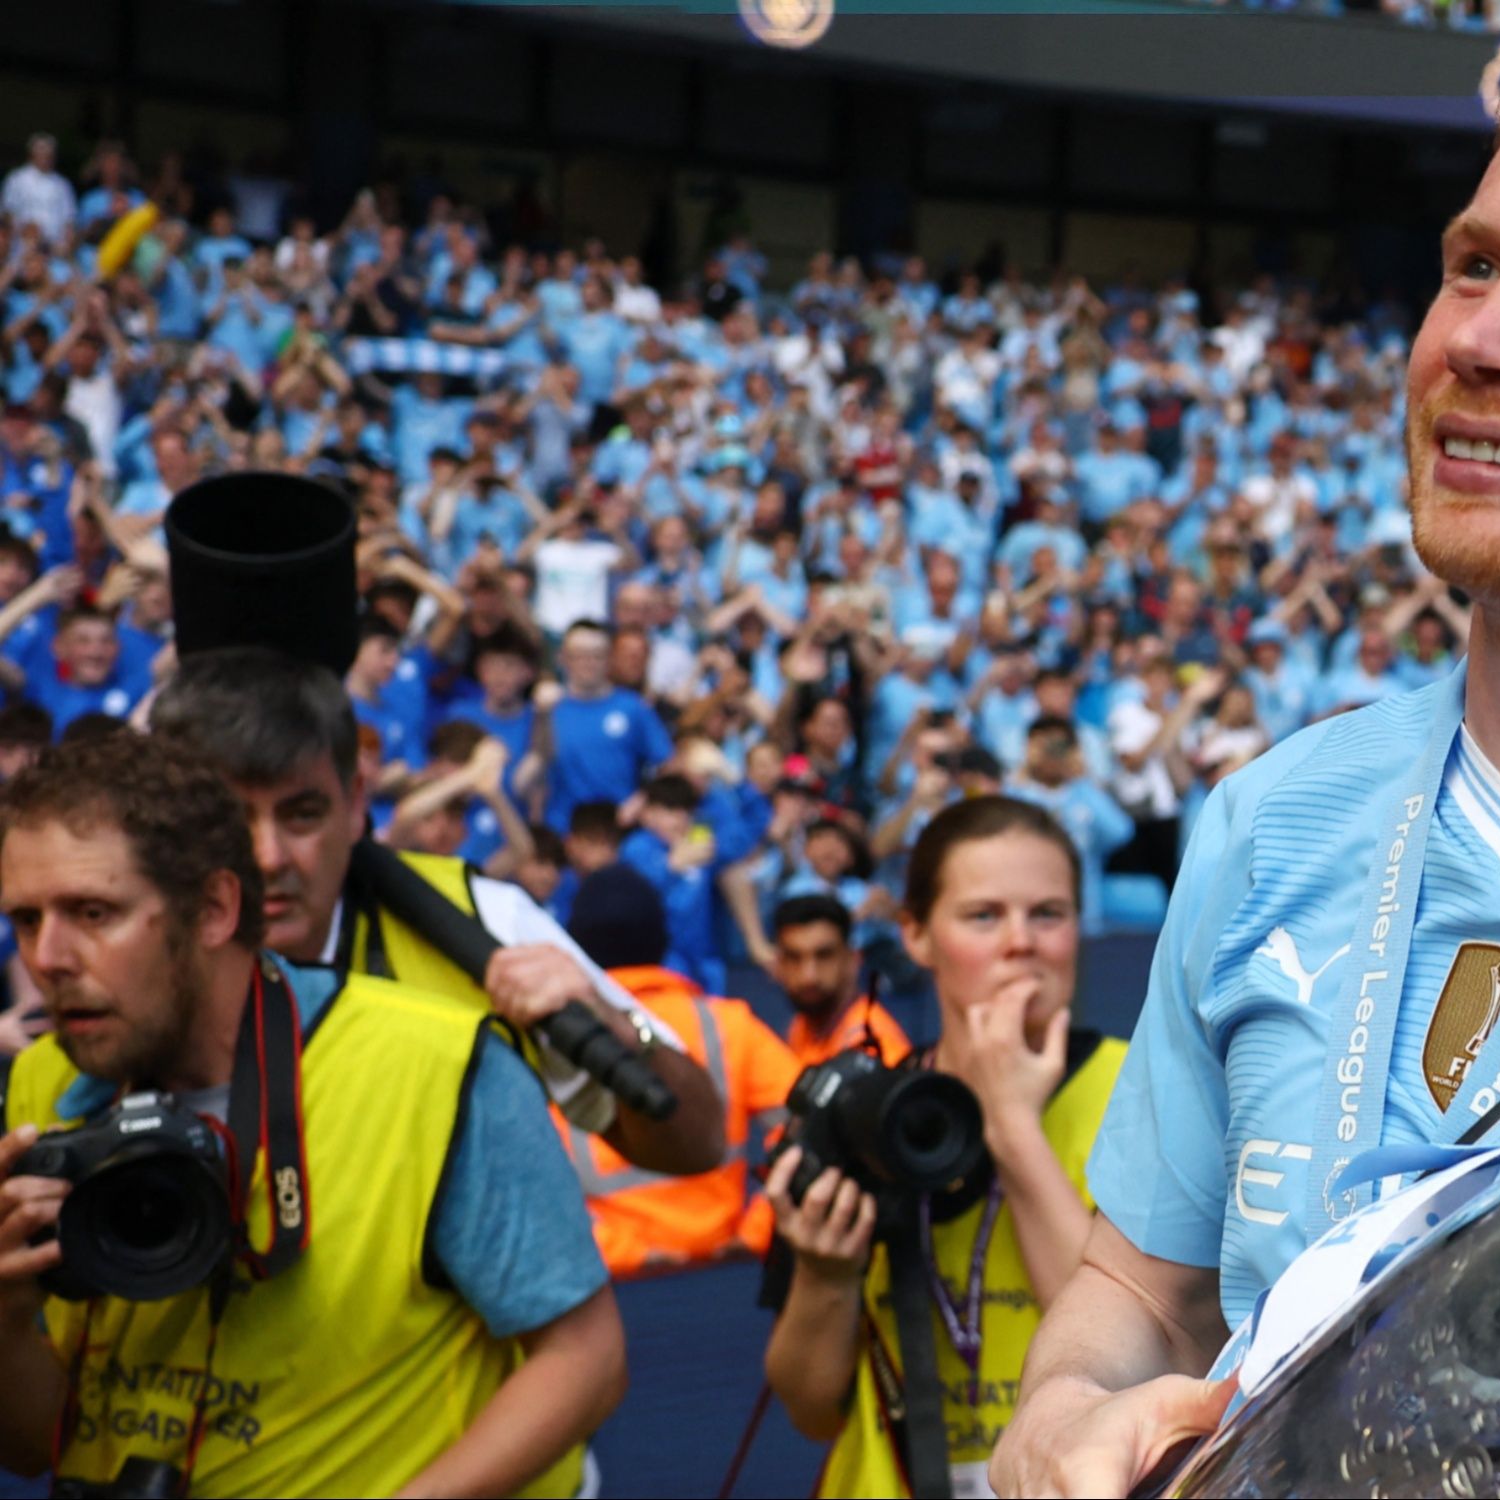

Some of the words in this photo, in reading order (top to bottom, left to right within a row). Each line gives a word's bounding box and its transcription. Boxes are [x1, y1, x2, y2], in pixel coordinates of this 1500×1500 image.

[1368, 793, 1425, 958] Premier
[1336, 970, 1389, 1142] League
[1431, 1074, 1460, 1089] WORLD
[1448, 1056, 1474, 1080] FI
[275, 1165, 301, 1229] EOS
